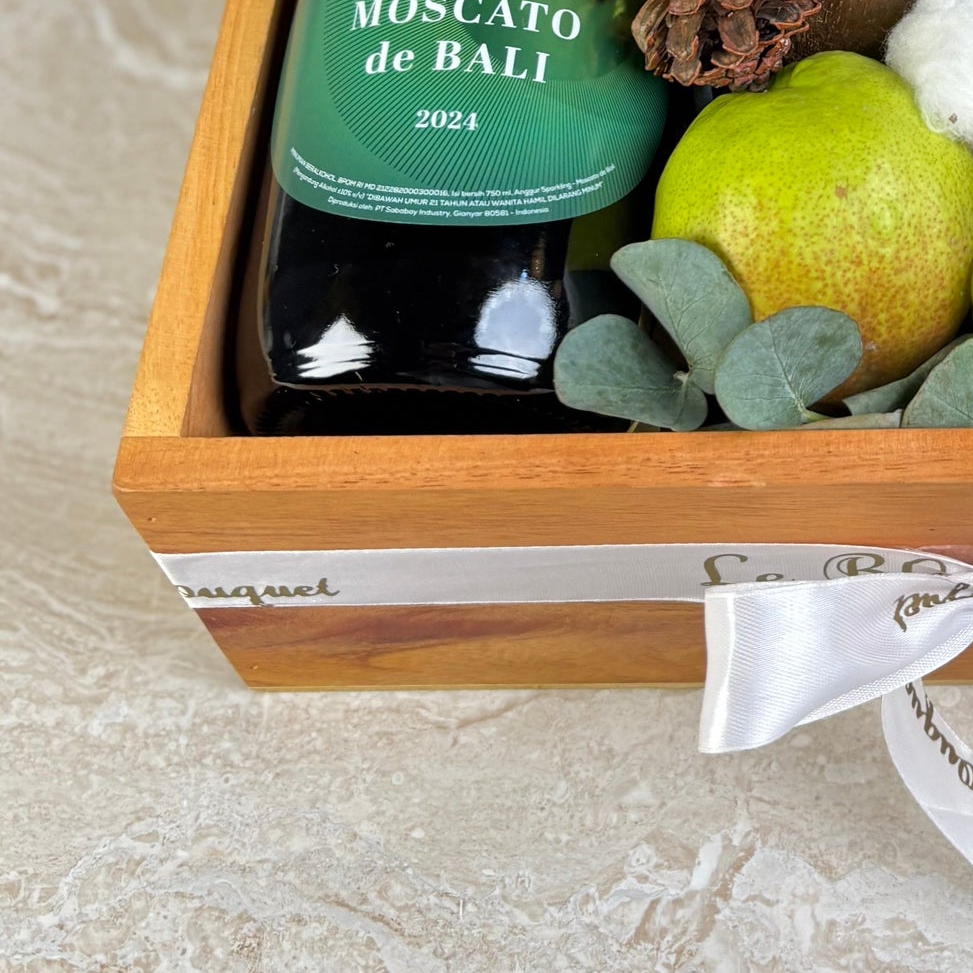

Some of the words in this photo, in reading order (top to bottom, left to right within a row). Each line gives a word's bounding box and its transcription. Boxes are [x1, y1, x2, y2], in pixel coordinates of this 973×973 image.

[364, 41, 415, 75] de
[431, 40, 550, 84] BALI
[414, 109, 479, 131] 2024
[404, 196, 428, 205] UMUR
[429, 198, 438, 206] 21
[440, 199, 468, 207] TAHUN
[469, 199, 490, 207] ATAU
[491, 197, 522, 207] WANITA
[523, 196, 547, 205] HAMIL
[485, 189, 501, 197] 750
[385, 206, 418, 216] Sababay
[453, 209, 483, 218] Gianyar
[484, 209, 509, 217] 80581
[515, 208, 549, 216] Indonesia
[176, 577, 341, 607] ouquet
